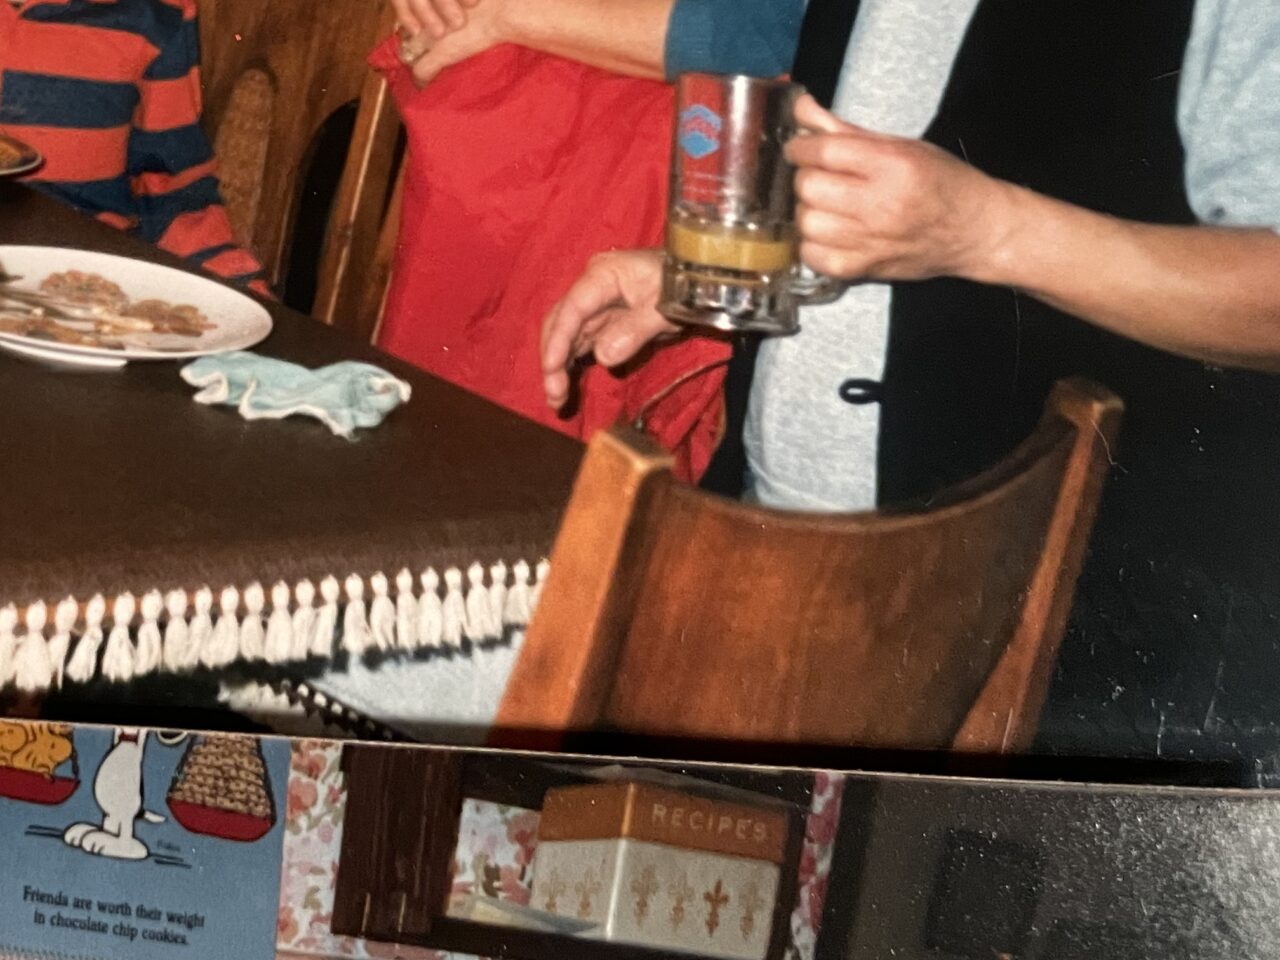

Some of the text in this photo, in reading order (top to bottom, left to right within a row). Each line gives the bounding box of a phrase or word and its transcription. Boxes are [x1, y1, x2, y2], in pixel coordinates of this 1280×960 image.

[651, 803, 767, 844] RECIPES
[23, 885, 205, 931] Friends are worth their weight
[33, 907, 46, 925] in
[50, 911, 109, 935] chocolate
[112, 921, 139, 943] chip
